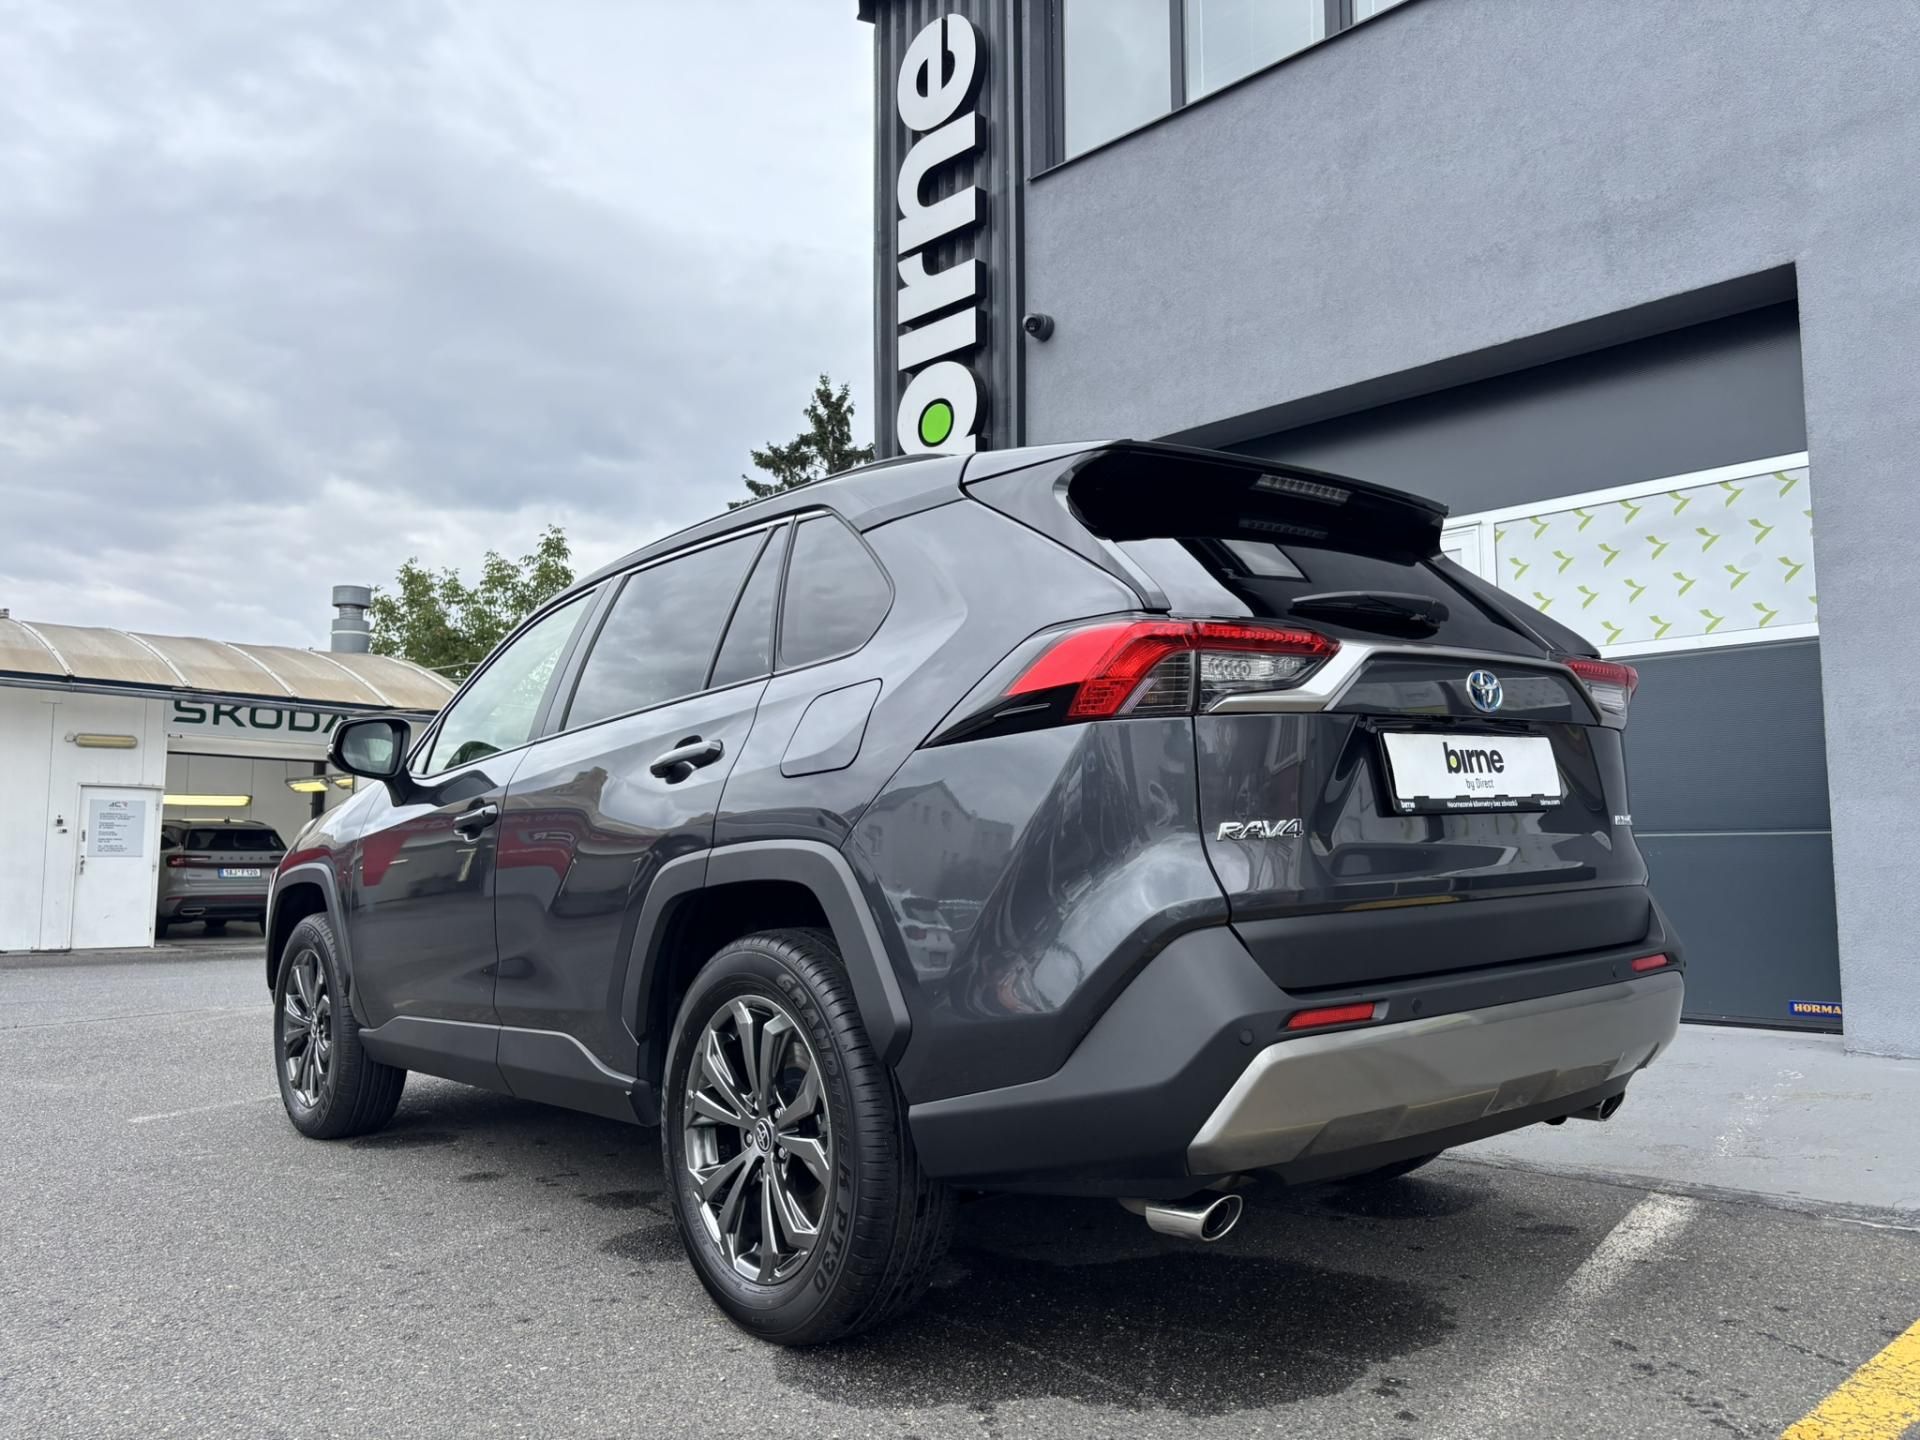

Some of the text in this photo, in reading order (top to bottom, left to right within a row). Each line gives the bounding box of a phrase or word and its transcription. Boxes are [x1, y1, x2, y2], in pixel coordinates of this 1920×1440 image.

[1443, 741, 1504, 774] birne
[1465, 778, 1495, 791] by Direct
[1217, 818, 1304, 841] RAV4
